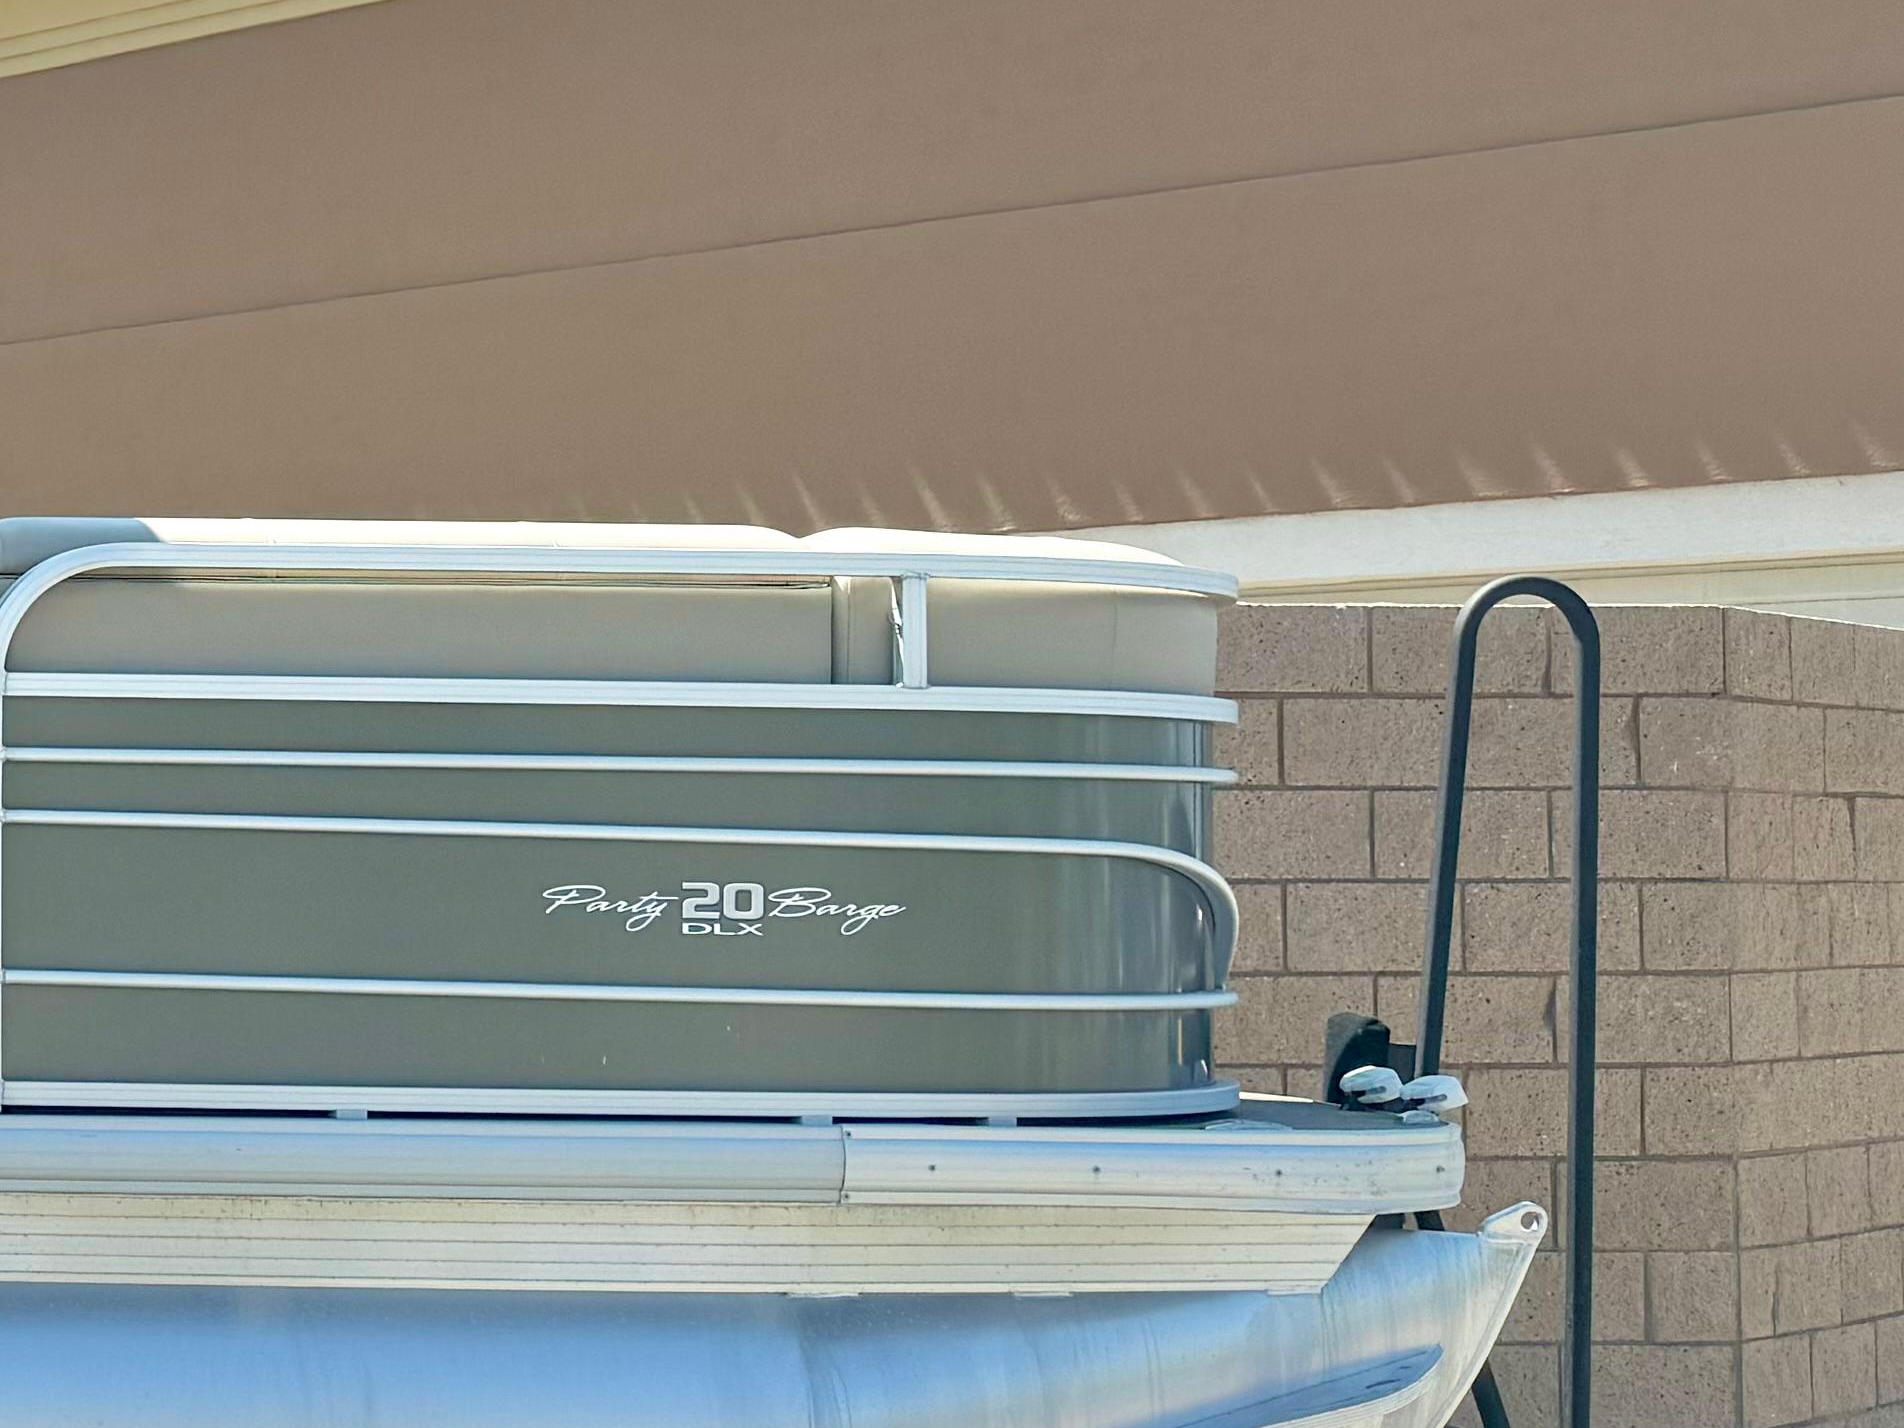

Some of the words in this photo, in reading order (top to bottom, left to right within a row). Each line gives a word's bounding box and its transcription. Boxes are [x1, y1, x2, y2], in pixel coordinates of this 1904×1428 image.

[541, 883, 680, 933] Party
[680, 881, 766, 921] 20
[765, 886, 907, 936] Barge
[681, 922, 766, 936] DLX
